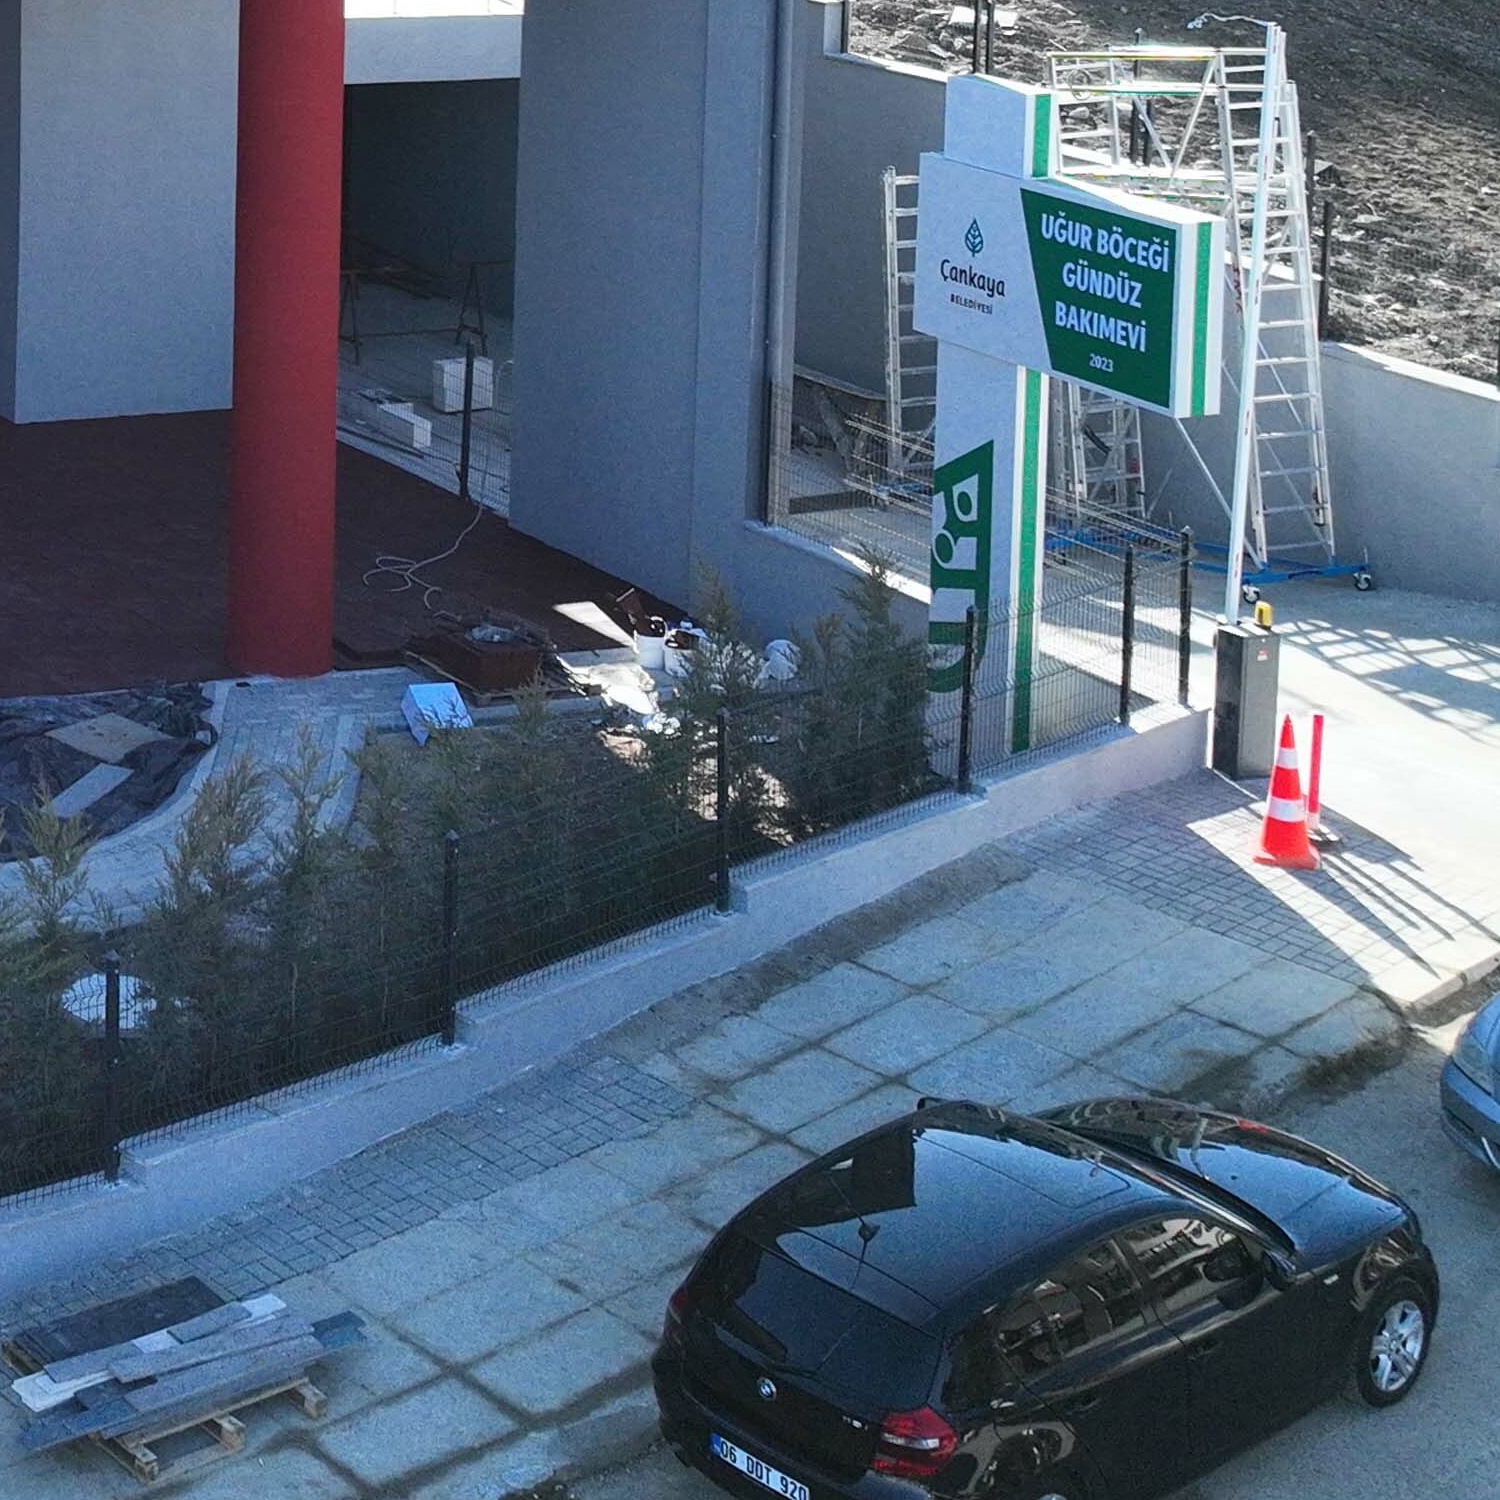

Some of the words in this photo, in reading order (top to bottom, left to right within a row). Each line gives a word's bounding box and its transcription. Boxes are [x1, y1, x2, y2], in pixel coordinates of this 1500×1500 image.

[1041, 210, 1093, 252] UĞUR
[1097, 226, 1170, 273] BÖCEĞİ
[940, 259, 1006, 299] Çankaya
[1062, 260, 1143, 309] GÜNDÜZ
[950, 294, 994, 315] BELEDİYESİ
[1055, 301, 1147, 353] BAKIMEVİ
[1089, 353, 1115, 373] 2023
[721, 1440, 737, 1464] 06
